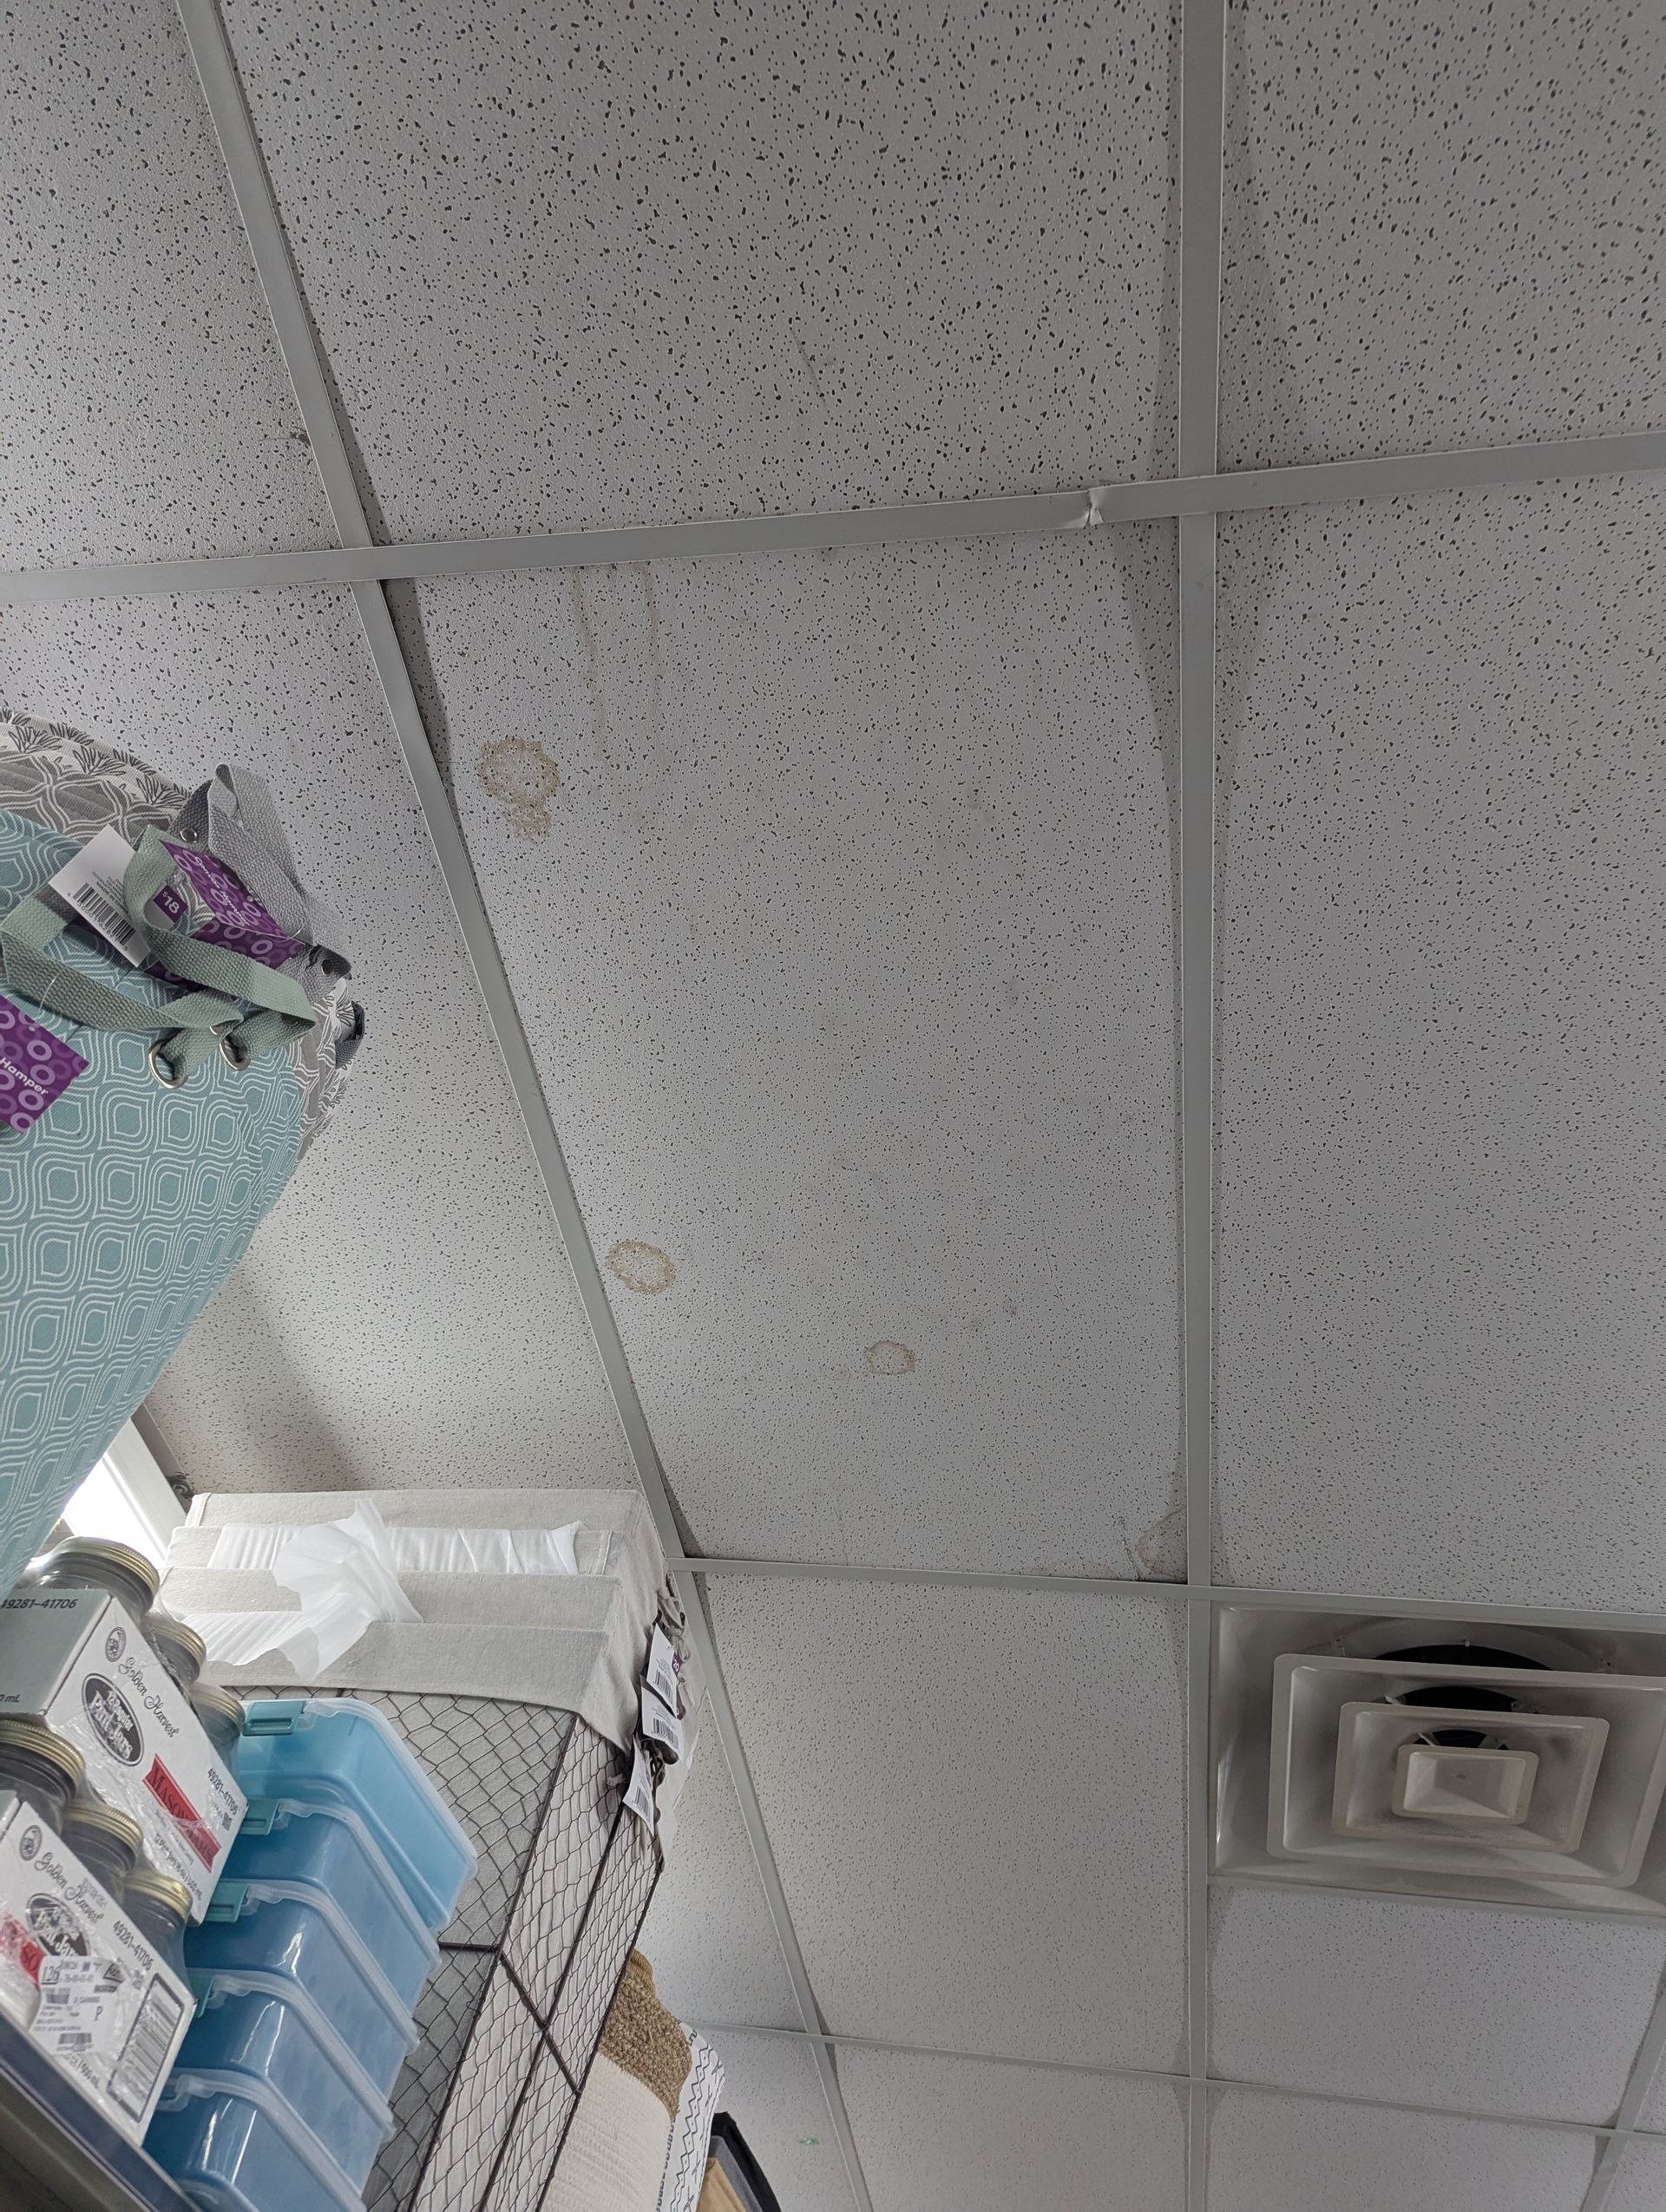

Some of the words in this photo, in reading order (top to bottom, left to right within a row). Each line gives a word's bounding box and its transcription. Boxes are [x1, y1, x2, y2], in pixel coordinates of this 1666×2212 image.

[95, 880, 109, 895] MADE
[0, 1057, 49, 1095] Hamper
[118, 1657, 148, 1697] Golden
[144, 1695, 180, 1738] Harvest
[34, 1852, 68, 1888] Golden
[65, 1885, 103, 1924] Harvest
